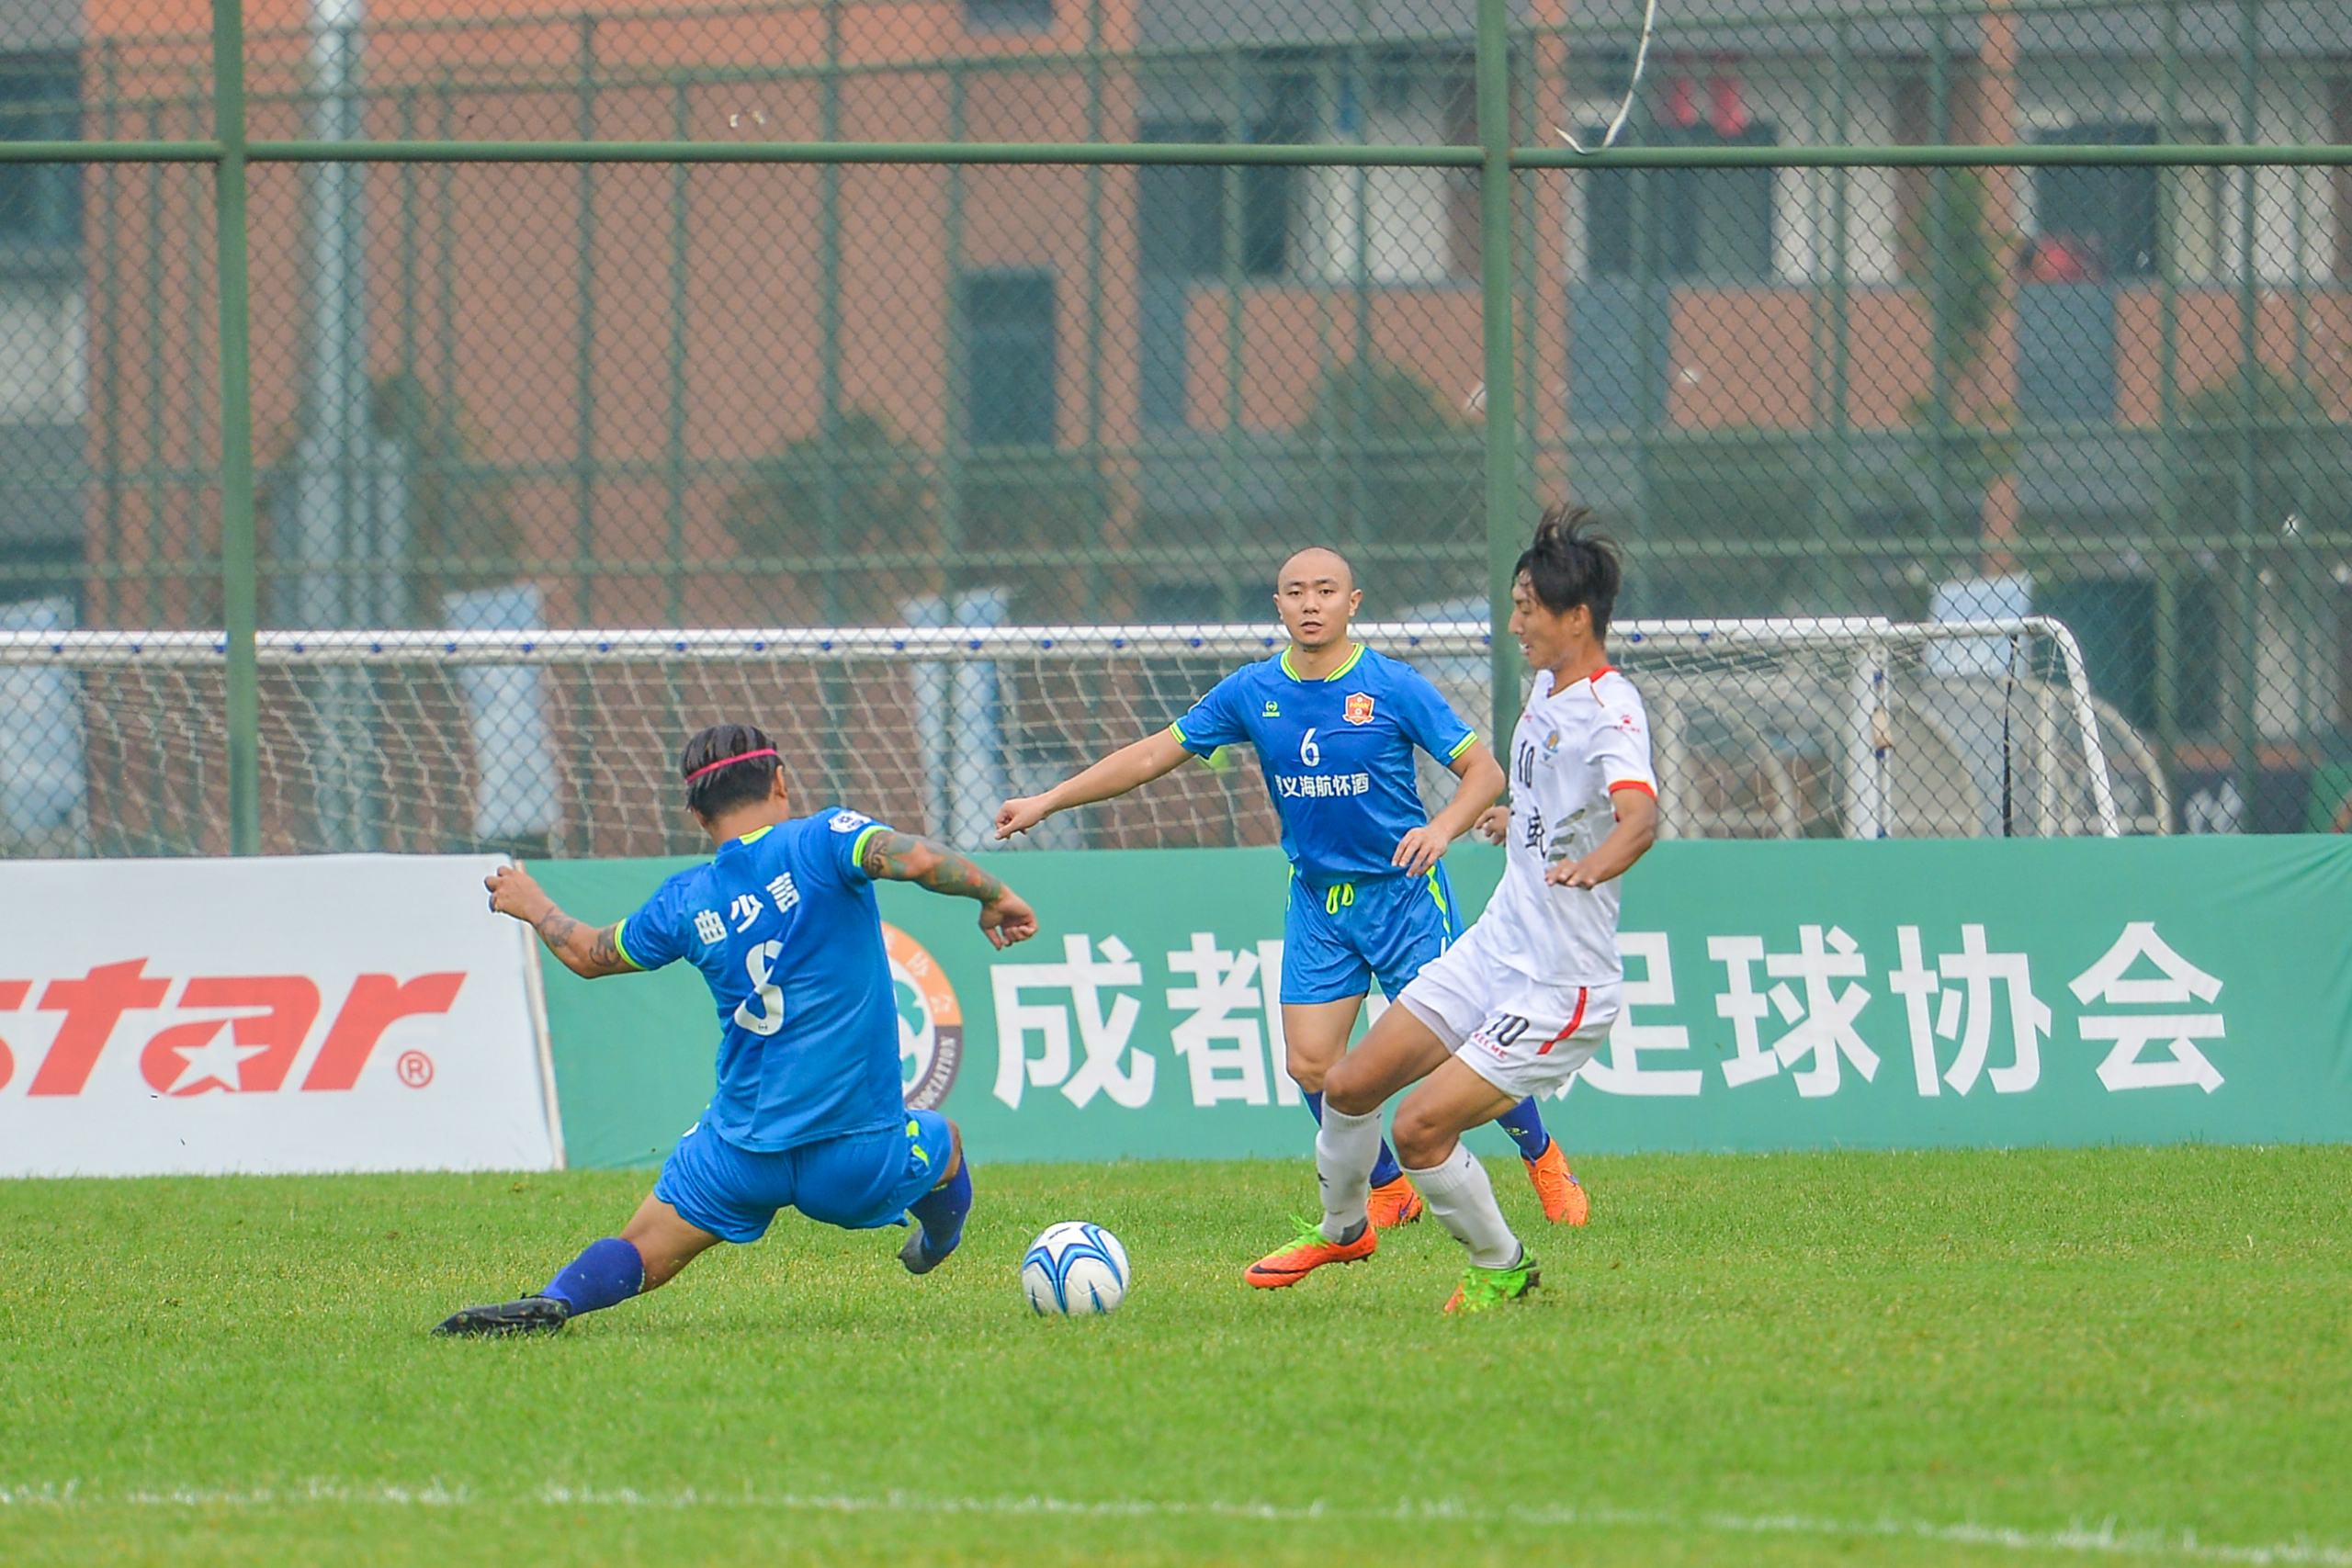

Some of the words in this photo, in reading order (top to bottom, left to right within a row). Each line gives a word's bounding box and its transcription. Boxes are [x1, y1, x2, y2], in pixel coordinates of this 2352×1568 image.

[1300, 728, 1320, 766] 6
[1518, 739, 1535, 789] 10
[1273, 773, 1370, 798] 义海航怀酒
[693, 871, 801, 946] 曲少言
[733, 939, 785, 1037] 8
[989, 921, 2227, 1111] 成都足球协会
[1485, 1012, 1530, 1046] 10
